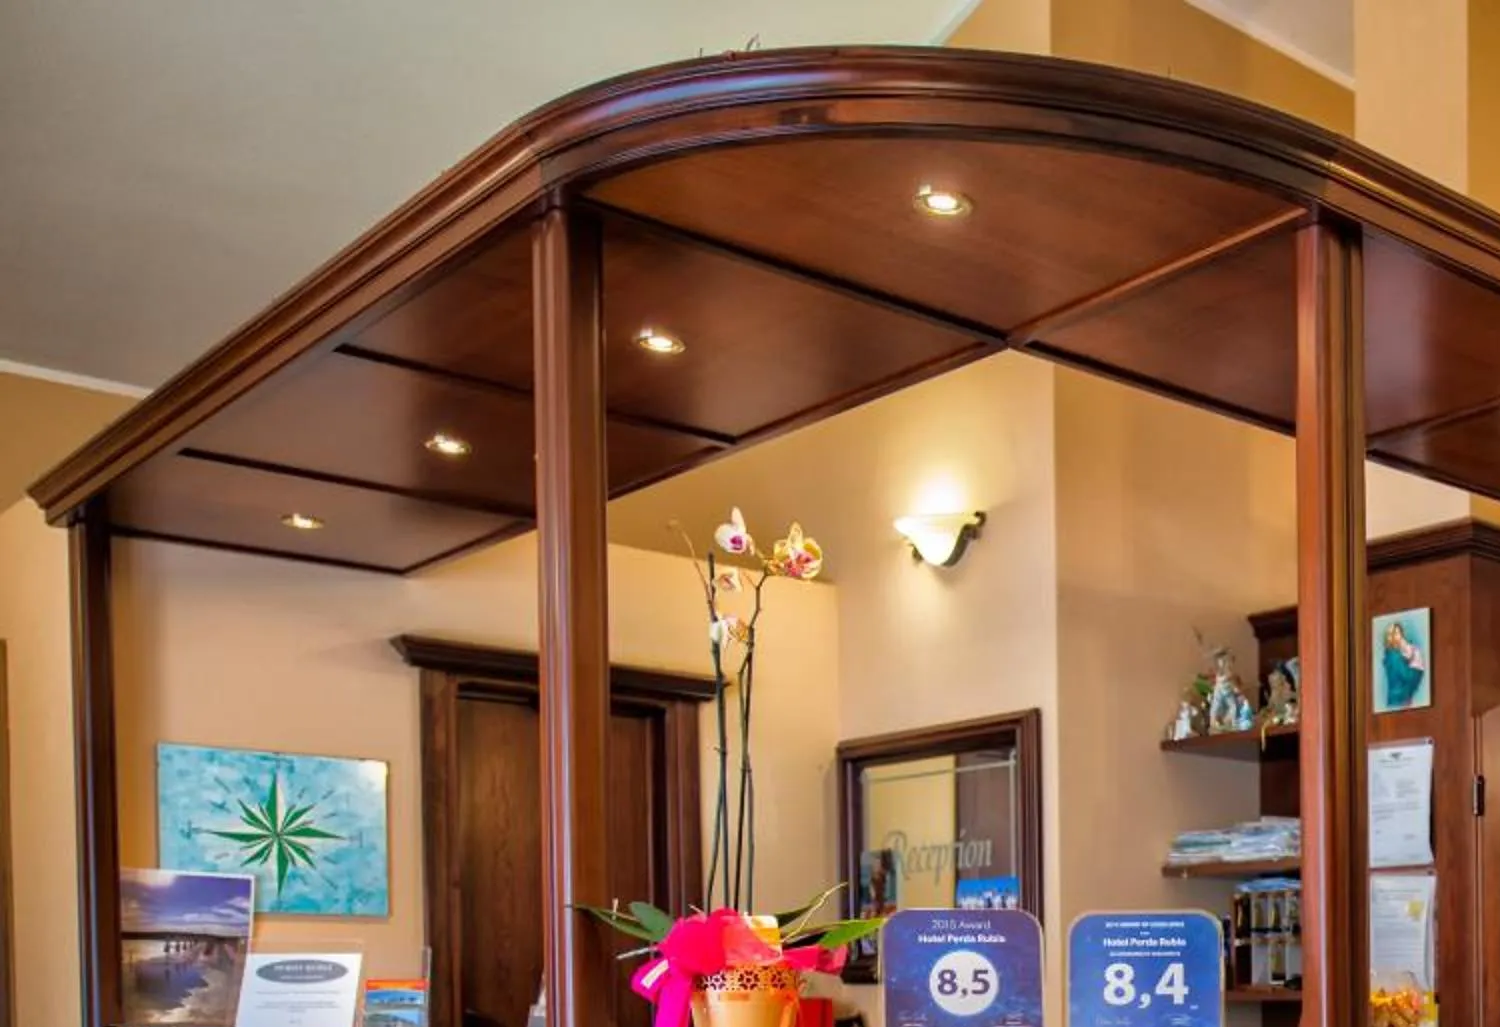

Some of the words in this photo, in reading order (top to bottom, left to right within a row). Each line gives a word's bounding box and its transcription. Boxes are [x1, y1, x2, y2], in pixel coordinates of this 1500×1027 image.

[885, 829, 992, 885] Reception
[958, 919, 992, 930] Award
[918, 933, 945, 943] Hotel
[1103, 937, 1129, 947] Hotel
[936, 968, 991, 999] 8,5
[1103, 962, 1190, 1009] 8,4
